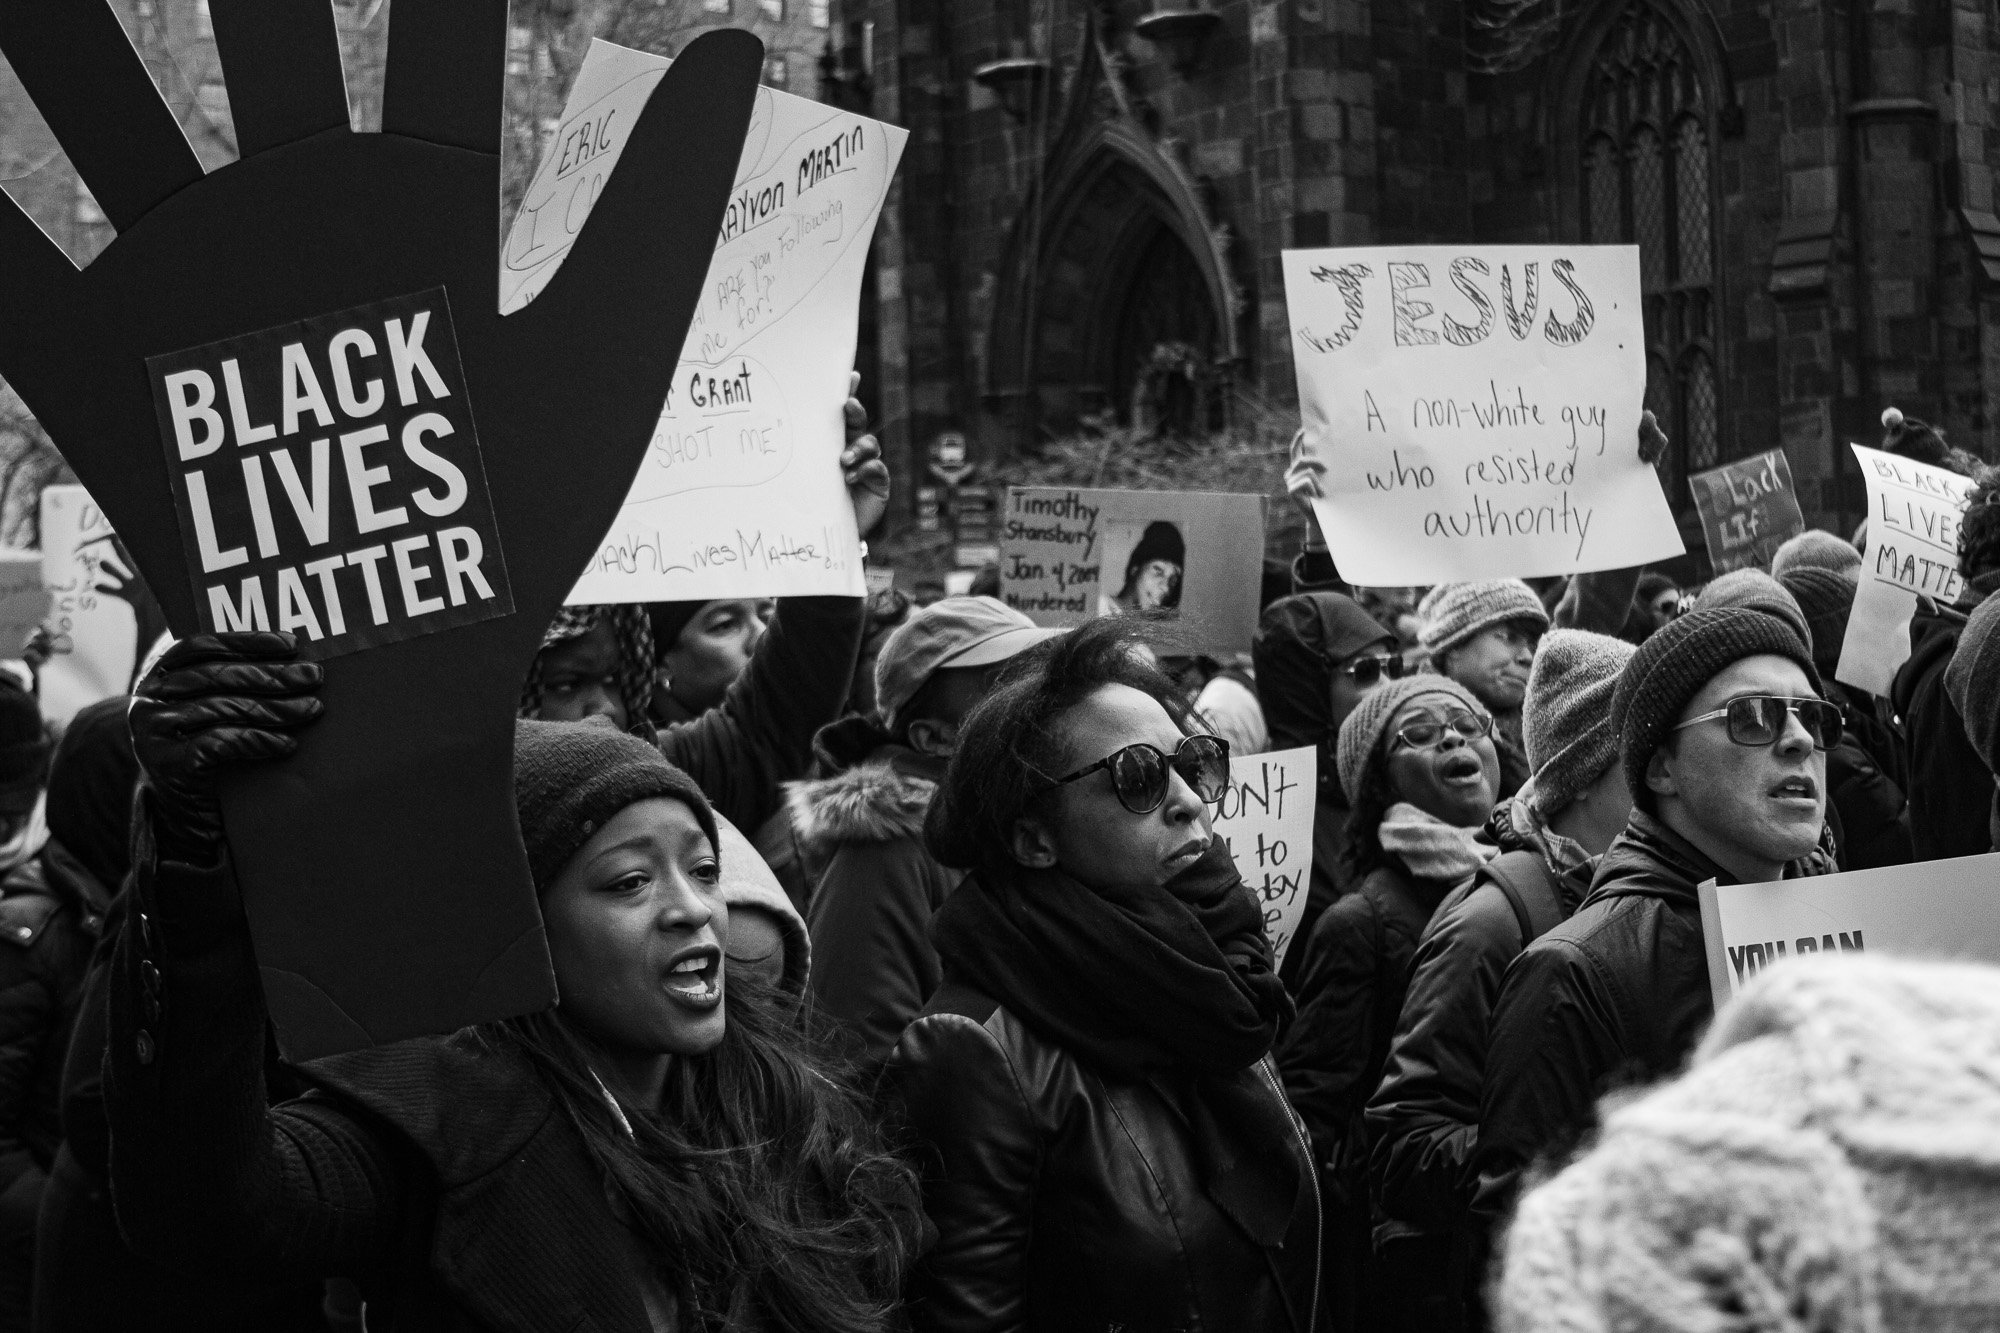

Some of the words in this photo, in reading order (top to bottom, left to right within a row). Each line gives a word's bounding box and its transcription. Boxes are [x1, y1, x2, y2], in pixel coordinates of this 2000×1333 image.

[556, 109, 616, 176] ERIC
[164, 310, 452, 462] BLACK
[654, 426, 715, 469] SHOT
[1363, 388, 1387, 433] A
[1412, 379, 1546, 431] non-white
[1560, 403, 1606, 456] guy
[185, 412, 469, 574] LIVES
[1366, 449, 1435, 490] who
[1464, 446, 1580, 486] resisted
[1872, 457, 1960, 502] BLACK
[1010, 490, 1099, 532] Timothy
[1423, 490, 1593, 562] authority
[207, 525, 497, 642] MATTER
[1875, 542, 1958, 598] MATTE
[1256, 832, 1288, 867] to
